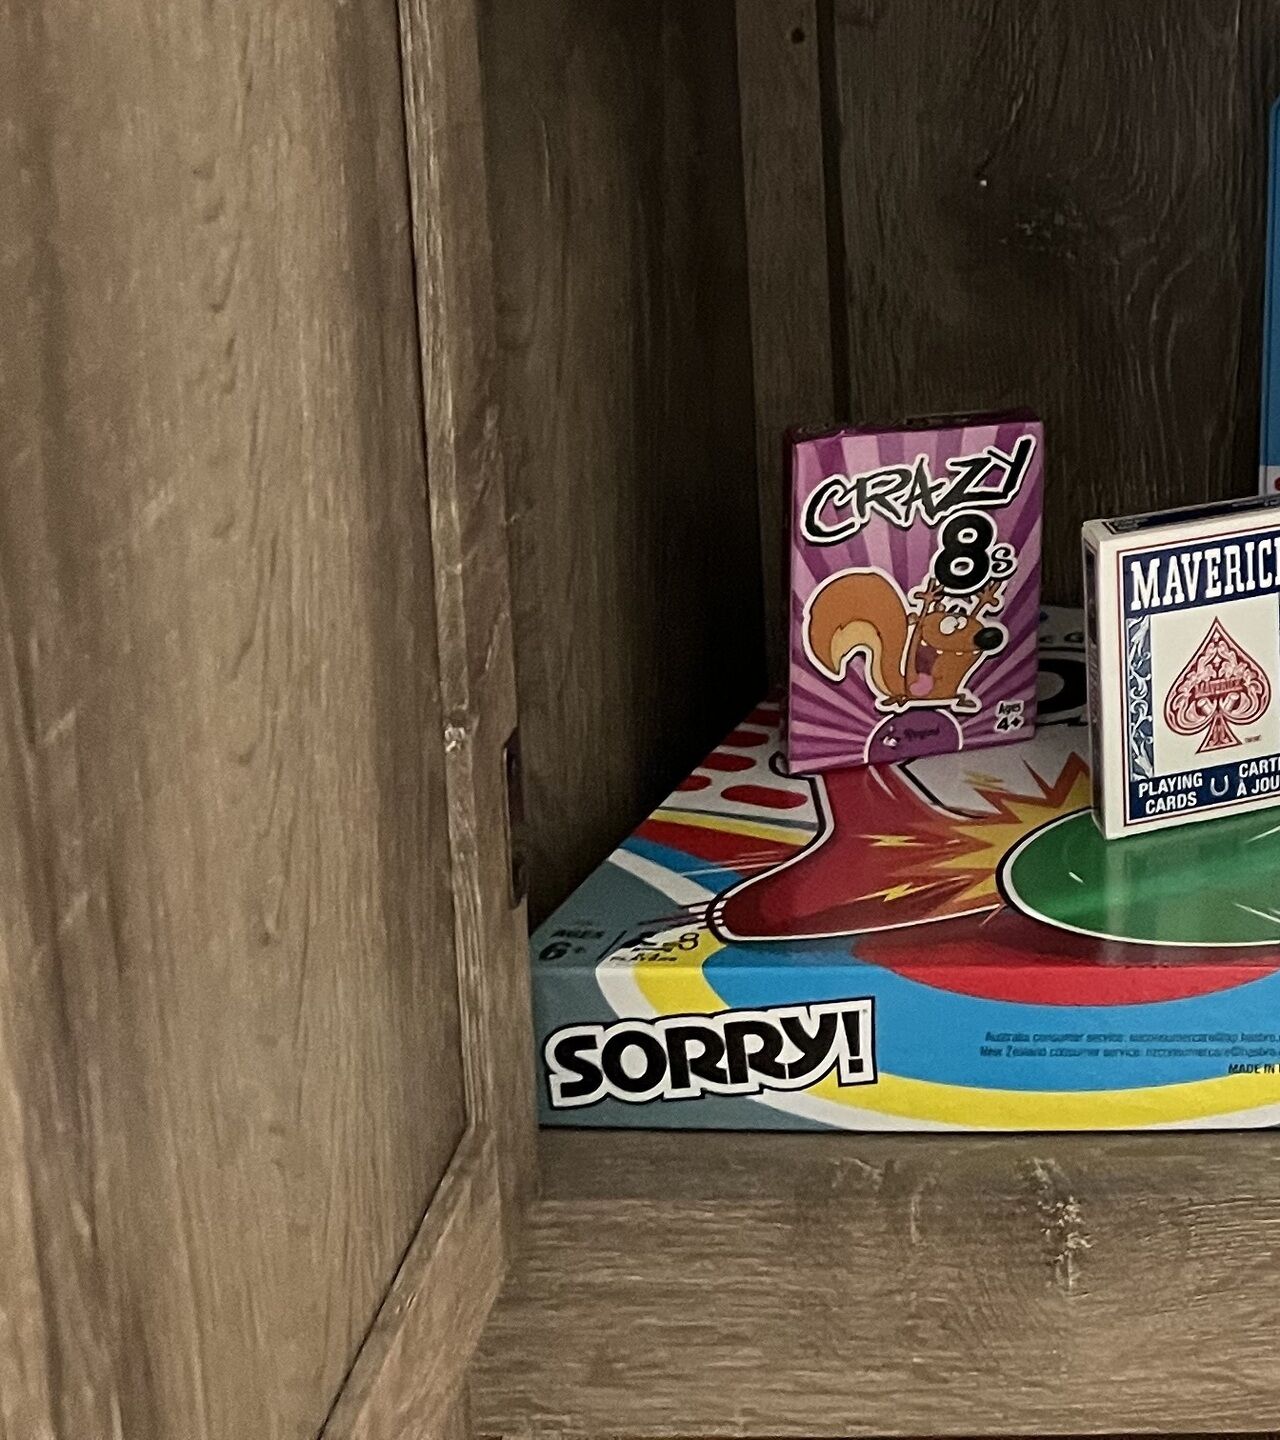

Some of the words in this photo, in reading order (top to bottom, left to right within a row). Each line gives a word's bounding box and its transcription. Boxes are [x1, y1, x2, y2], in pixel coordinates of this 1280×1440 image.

[803, 436, 1035, 542] CRAZY
[1138, 772, 1203, 799] PLAYING
[1145, 790, 1198, 815] CARDS
[555, 1011, 865, 1099] SORRY!
[1228, 1063, 1261, 1074] MADE
[1263, 1063, 1275, 1074] IN
